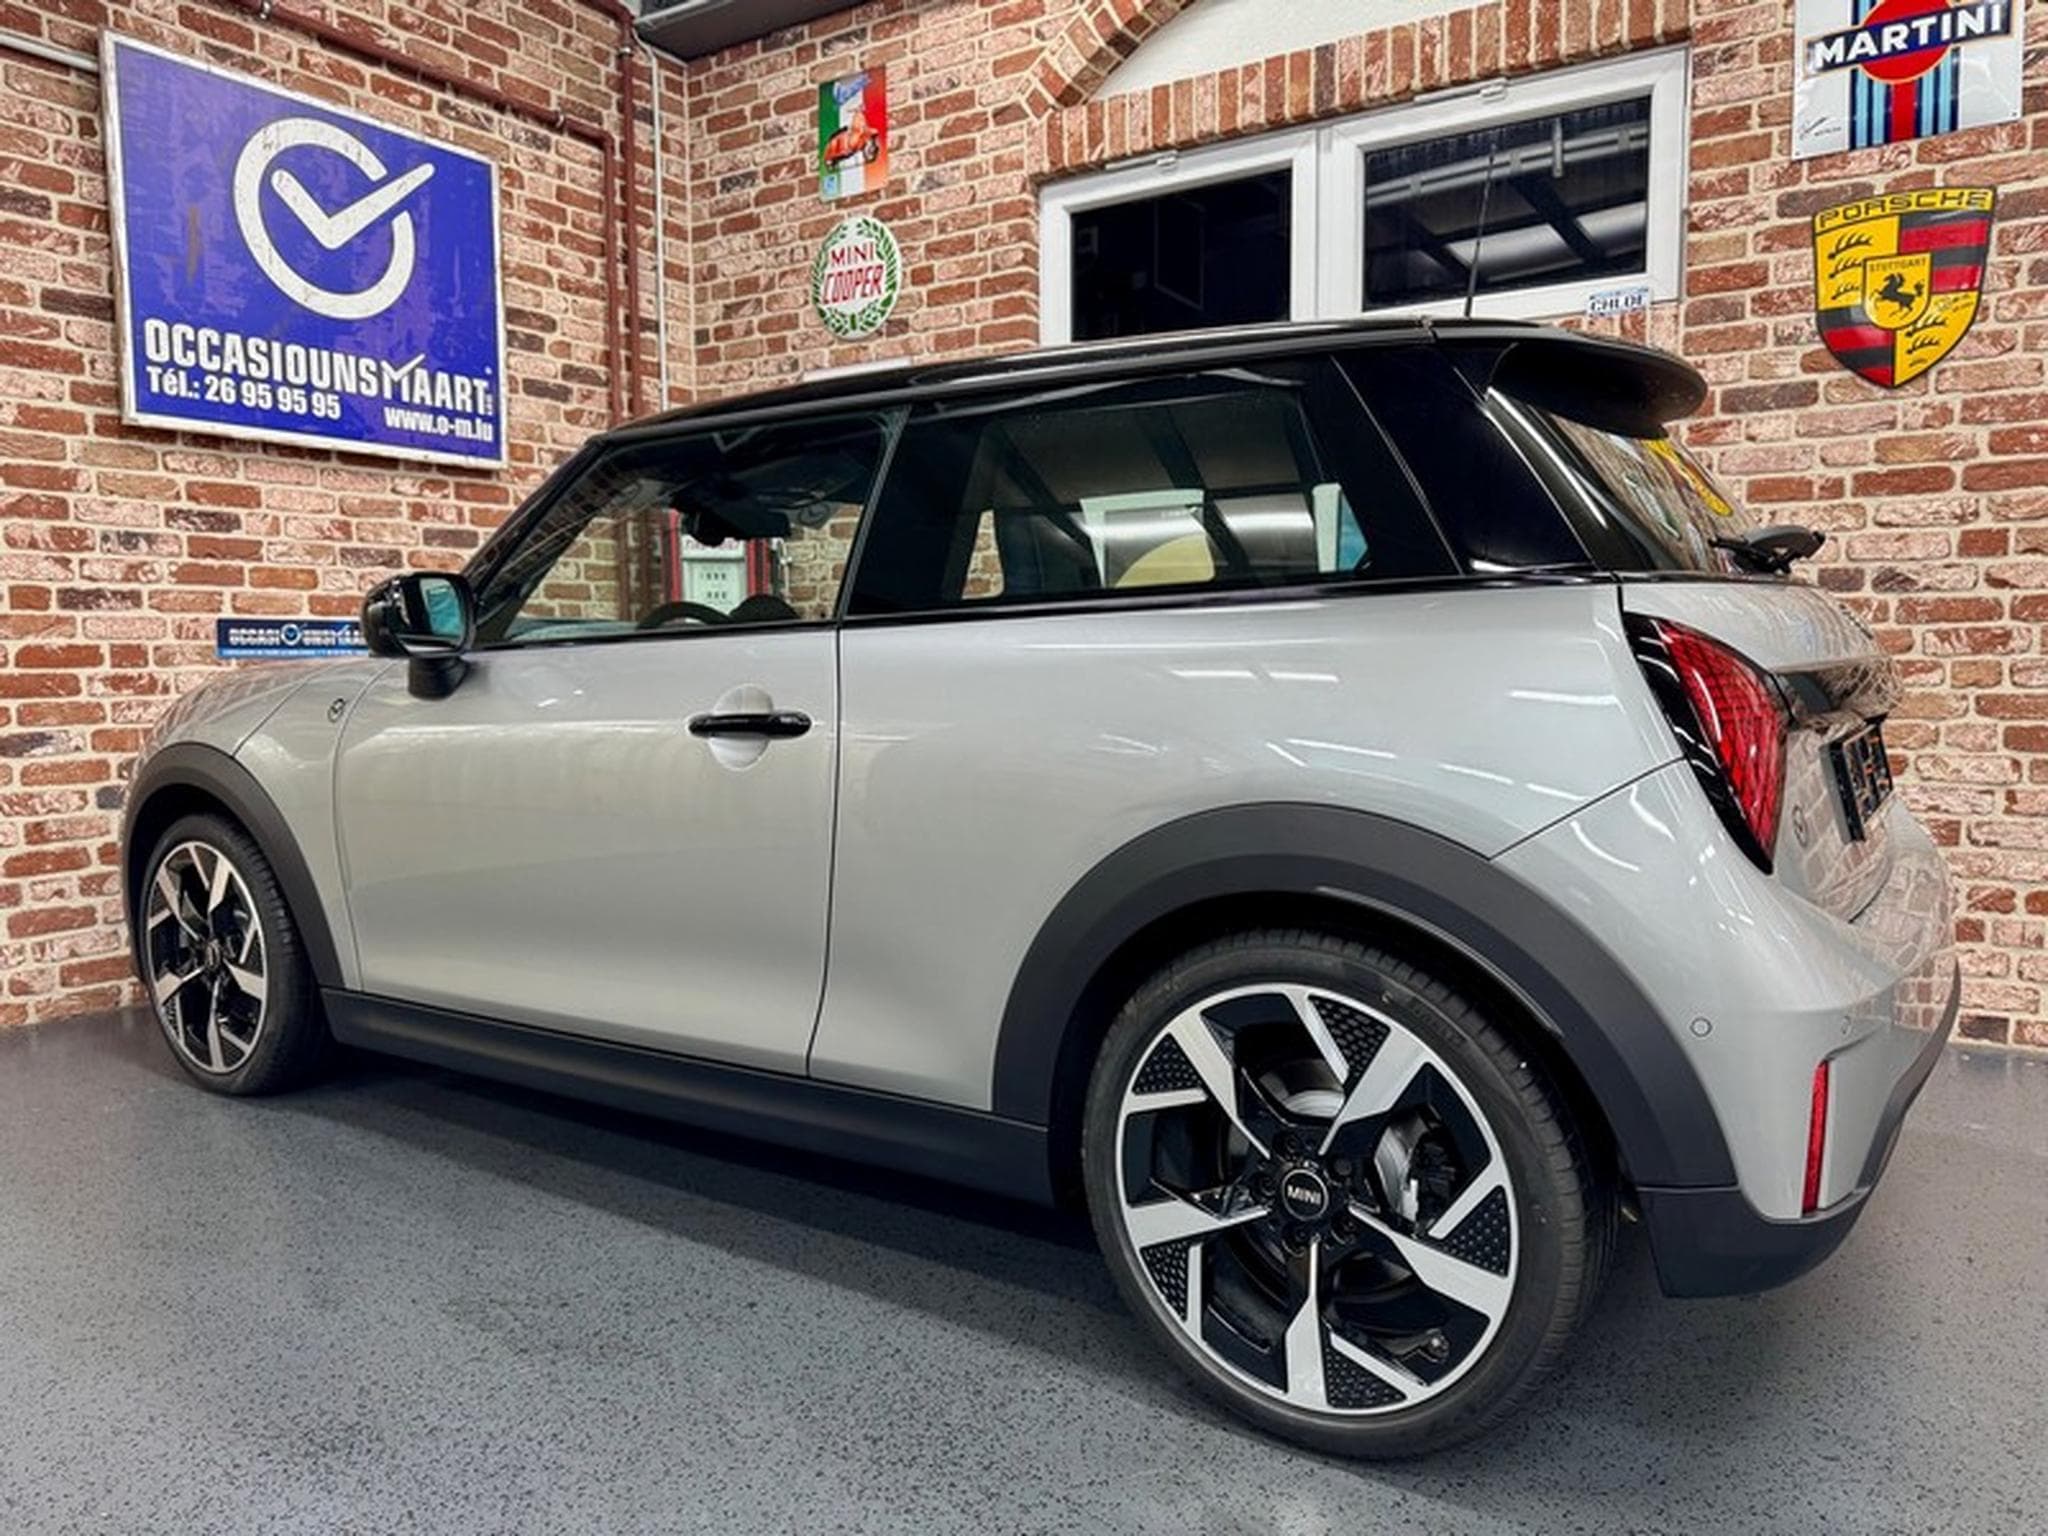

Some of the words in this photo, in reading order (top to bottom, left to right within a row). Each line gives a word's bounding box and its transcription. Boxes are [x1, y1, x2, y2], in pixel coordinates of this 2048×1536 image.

[1813, 4, 2001, 69] MARTINI
[1820, 191, 1988, 228] PORSCHE
[832, 242, 874, 267] MINI
[823, 265, 883, 304] COOPER
[146, 365, 200, 399] Tél.:
[204, 375, 236, 404] 26
[241, 380, 273, 410] 95
[277, 386, 307, 415] 95
[311, 392, 341, 420] 95
[384, 407, 493, 442] www.o-m.lu
[1287, 1185, 1321, 1205] MINI
